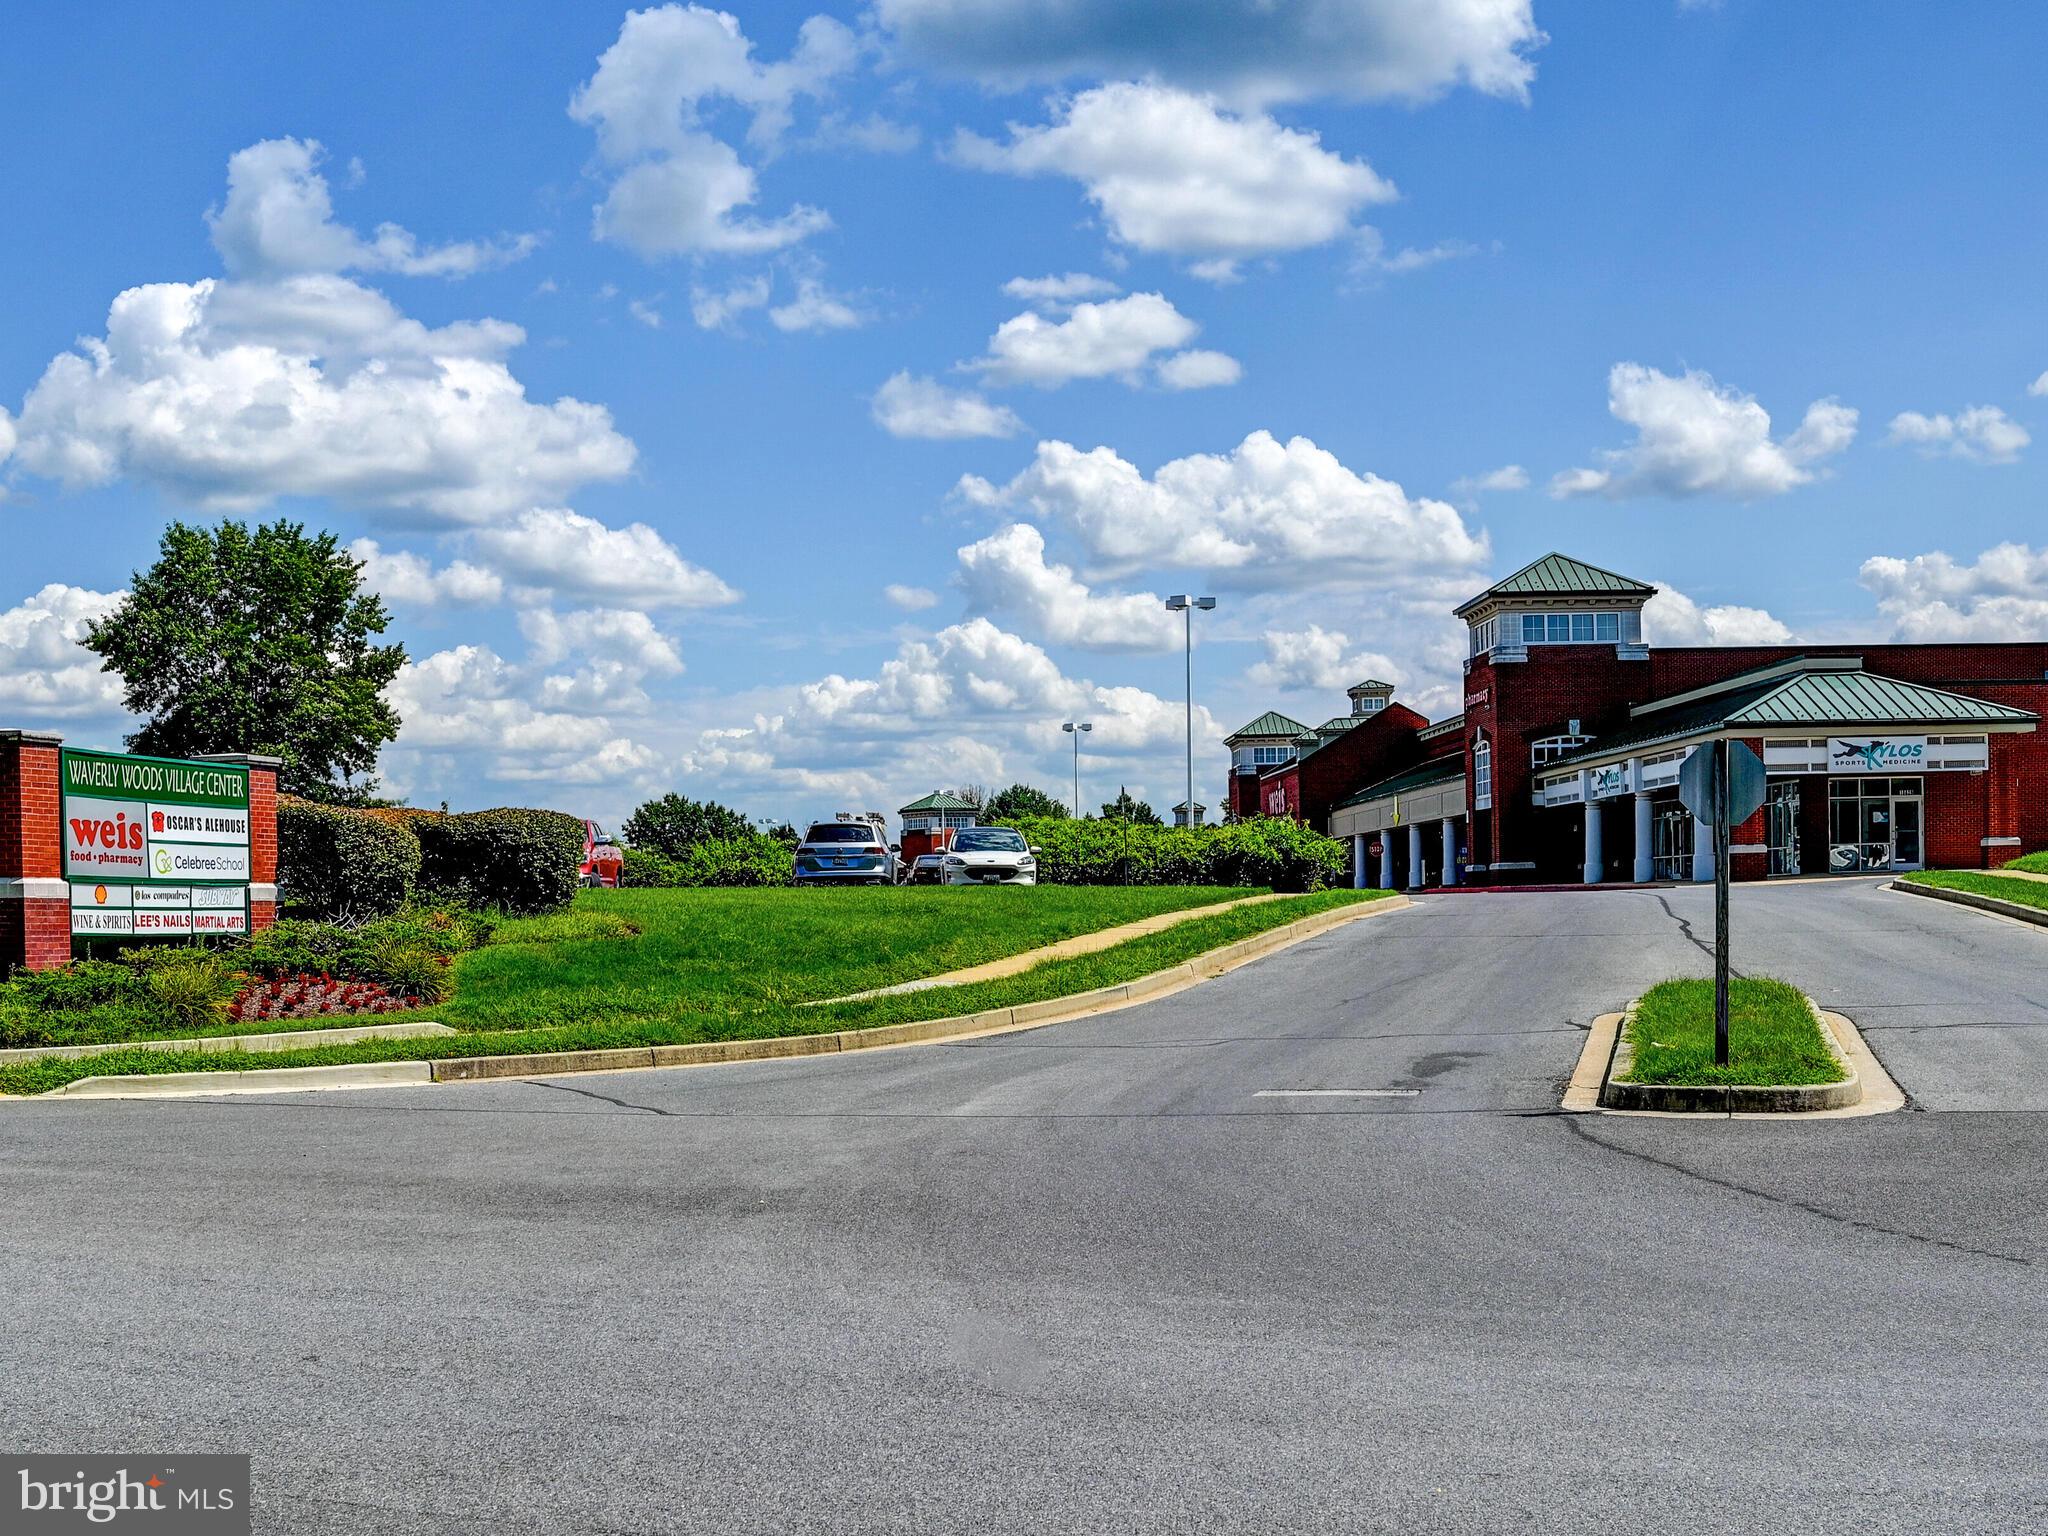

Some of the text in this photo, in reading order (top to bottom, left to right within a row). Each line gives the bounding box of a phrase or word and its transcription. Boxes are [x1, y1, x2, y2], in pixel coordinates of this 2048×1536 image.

[68, 759, 244, 797] WAVERLY WOODS VILLAGE CENTER
[69, 812, 143, 850] weis
[166, 815, 246, 834] OSCAR'S ALEHOUSE
[70, 850, 144, 866] food pharmacy
[141, 889, 190, 902] los compadres
[198, 888, 240, 906] SUBWAY
[72, 914, 131, 929] WINE & SPIRITS
[134, 914, 191, 928] LEE'S NAILS
[194, 916, 244, 928] MARTIAL ARTS
